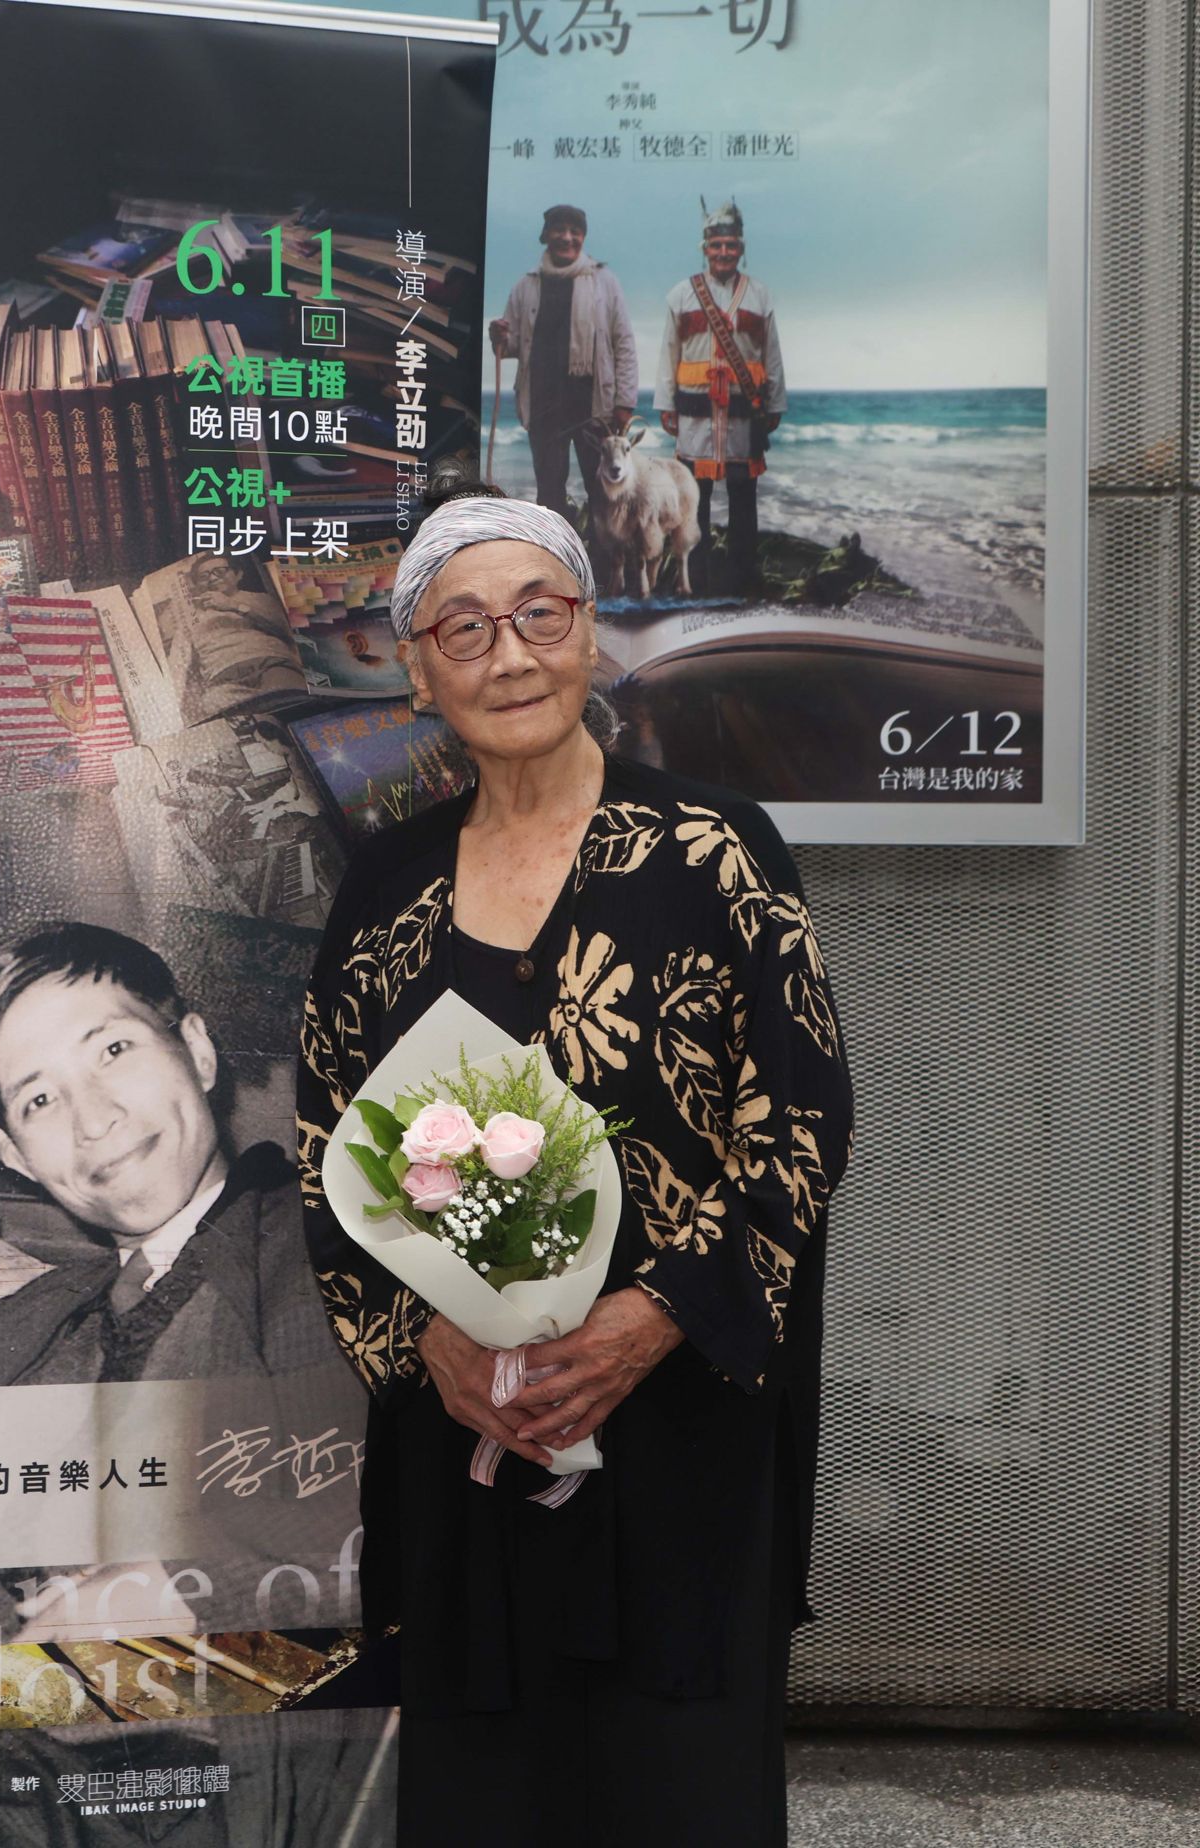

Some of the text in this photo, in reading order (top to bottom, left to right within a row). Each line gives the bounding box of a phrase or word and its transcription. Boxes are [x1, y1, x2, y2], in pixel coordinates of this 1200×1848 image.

[552, 136, 622, 160] 戴宏基
[640, 135, 708, 159] 牧德全
[726, 134, 795, 158] 潘世光
[175, 219, 342, 300] 6.11
[310, 314, 337, 341] 四
[184, 354, 347, 399] 公視首播
[189, 405, 348, 444] 晚間10點
[184, 466, 292, 508] 公視+
[188, 515, 349, 559] 同步上架
[879, 710, 1023, 756] 6/12
[878, 766, 1024, 791] 台灣是我的家
[11, 1776, 41, 1792] 製作
[80, 1798, 207, 1816] IBAK IMAGE STUDIO
